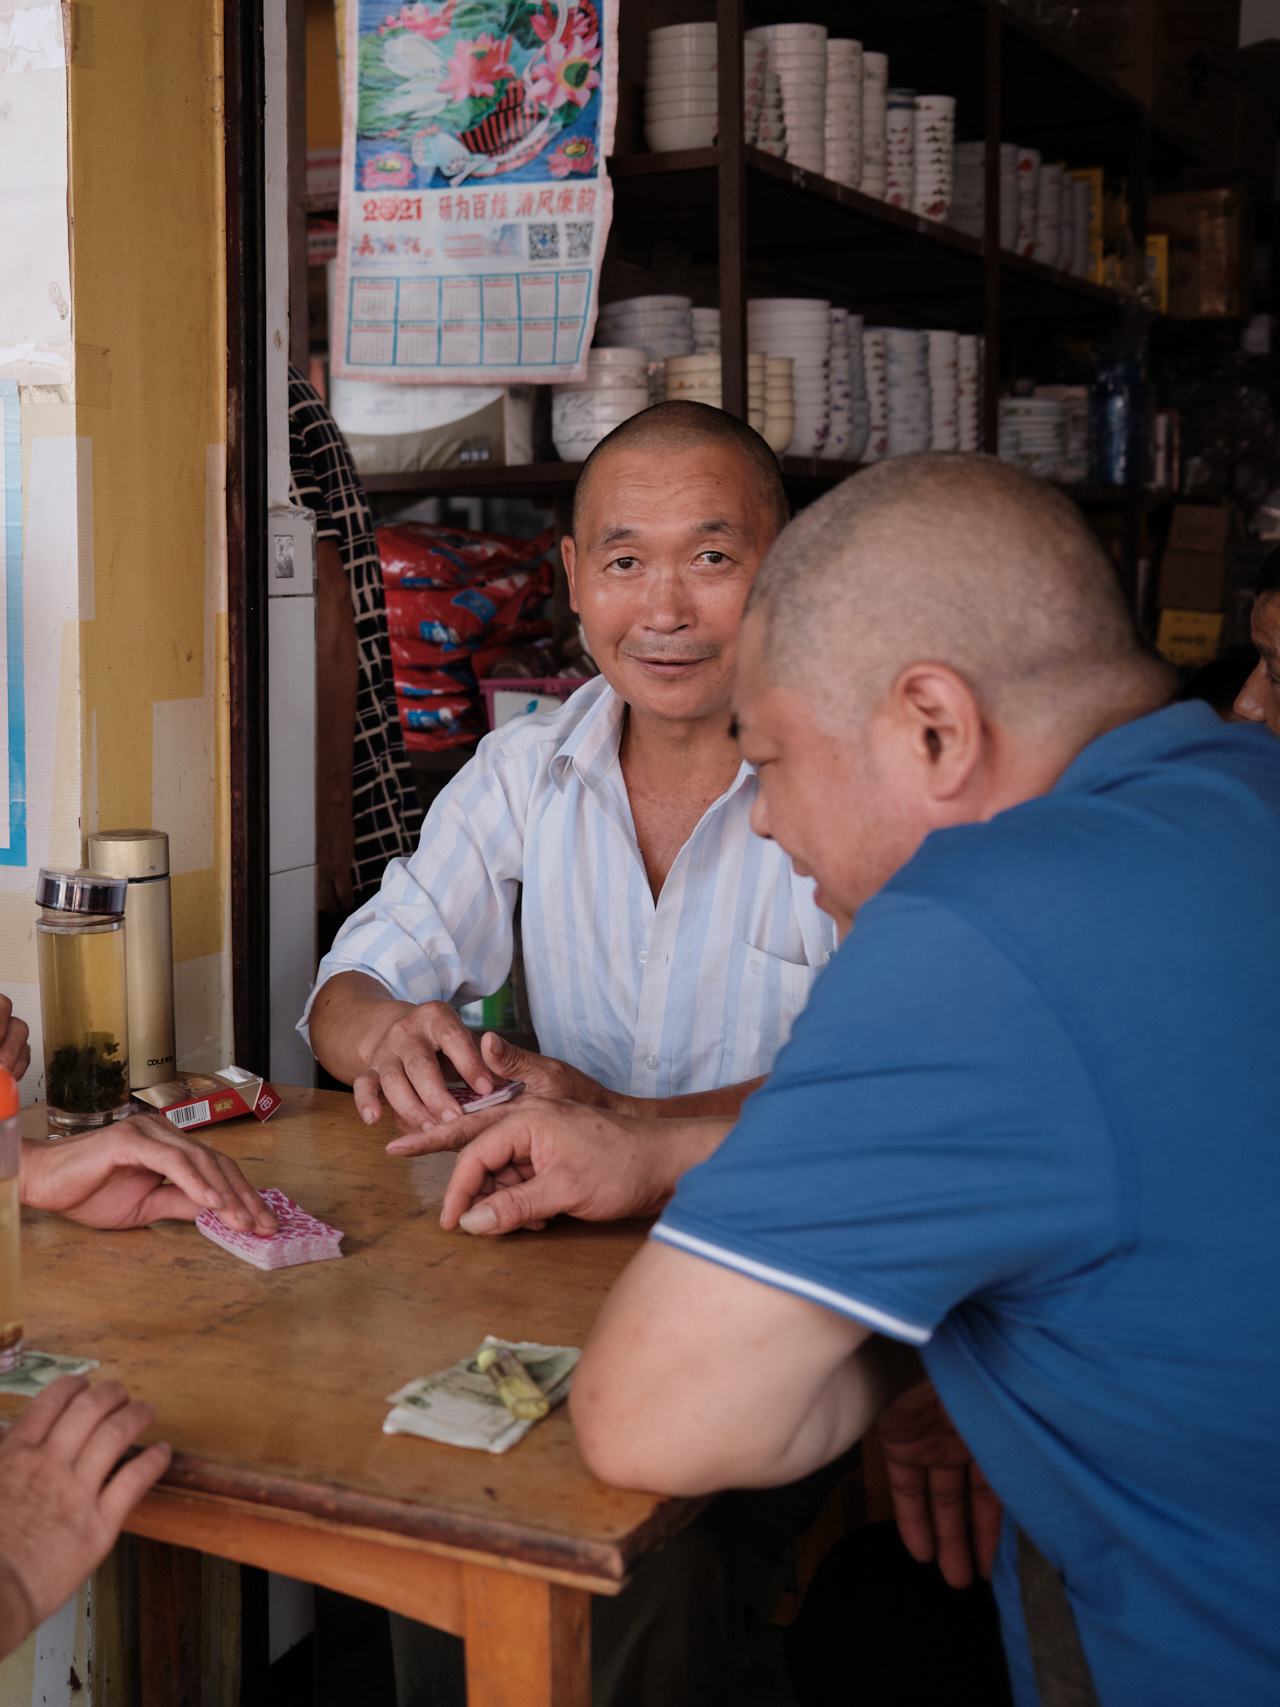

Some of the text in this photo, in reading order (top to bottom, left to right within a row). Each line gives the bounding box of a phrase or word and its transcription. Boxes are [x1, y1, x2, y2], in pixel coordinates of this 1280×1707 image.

[363, 197, 423, 222] 2021
[515, 187, 597, 217] 清风廉韵
